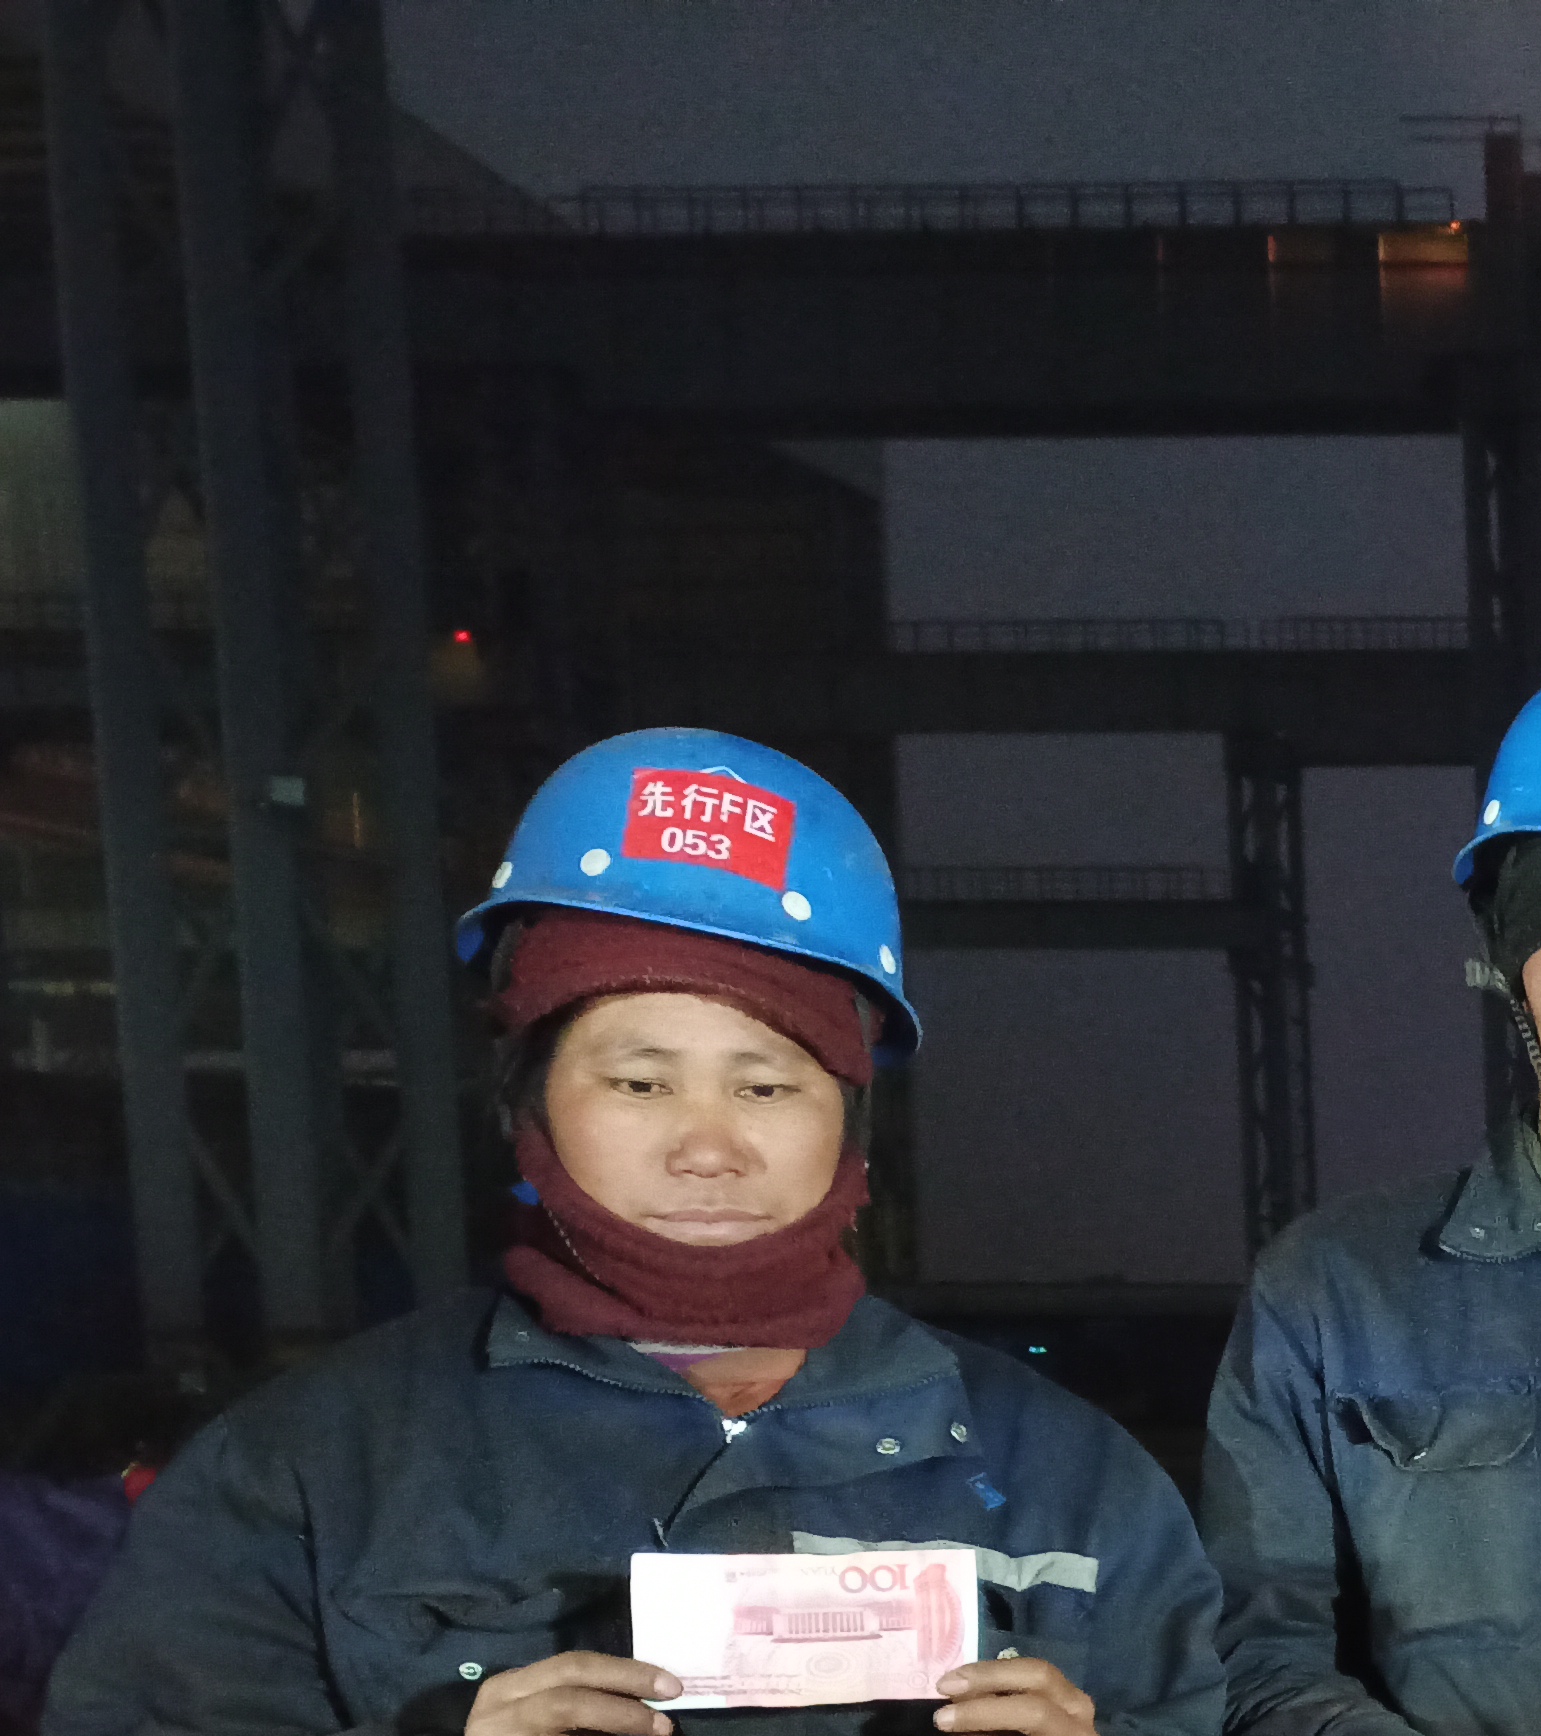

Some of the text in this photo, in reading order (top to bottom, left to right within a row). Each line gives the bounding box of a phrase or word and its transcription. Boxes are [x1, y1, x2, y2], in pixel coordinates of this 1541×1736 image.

[638, 780, 779, 842] 先行F区
[660, 826, 732, 860] 053
[838, 1563, 910, 1594] 100
